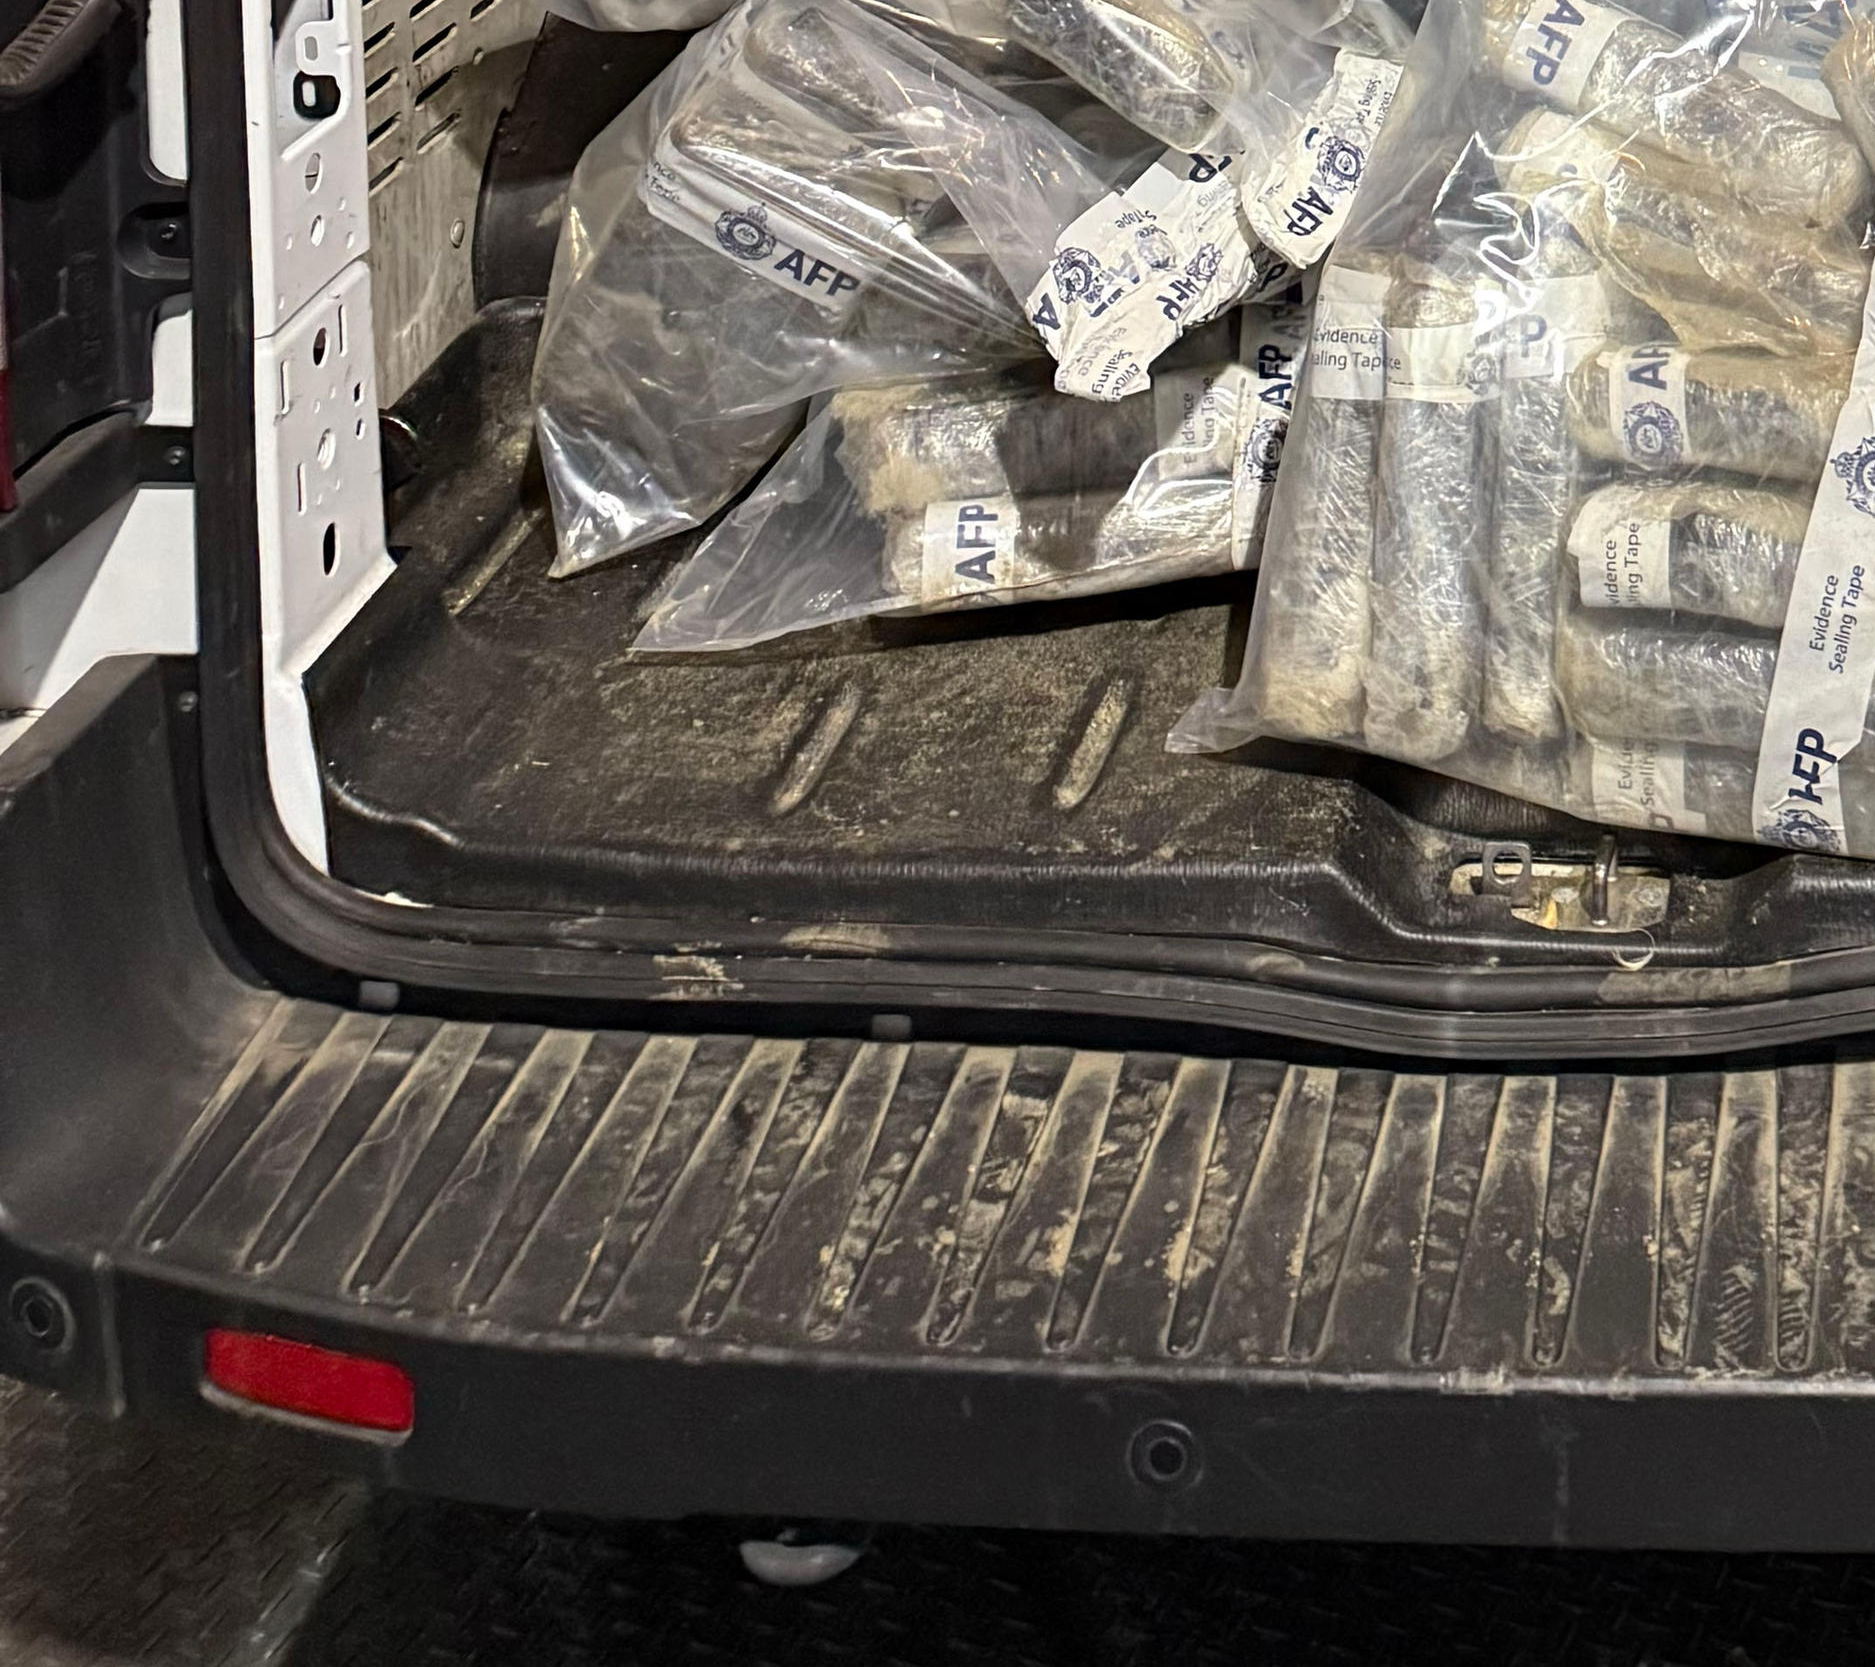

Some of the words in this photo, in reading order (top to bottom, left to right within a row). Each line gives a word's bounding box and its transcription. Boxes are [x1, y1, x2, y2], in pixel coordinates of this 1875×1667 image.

[1284, 185, 1334, 236] AFP
[773, 248, 863, 297] AFP
[1258, 344, 1293, 411] AFP
[1183, 392, 1196, 465] Eidence
[955, 502, 998, 585] AFP
[1624, 522, 1641, 568] Tape
[1809, 574, 1839, 653] Evidence
[1829, 613, 1858, 675] Sealing
[1844, 564, 1865, 611] Tape
[1788, 727, 1838, 805] AFP
